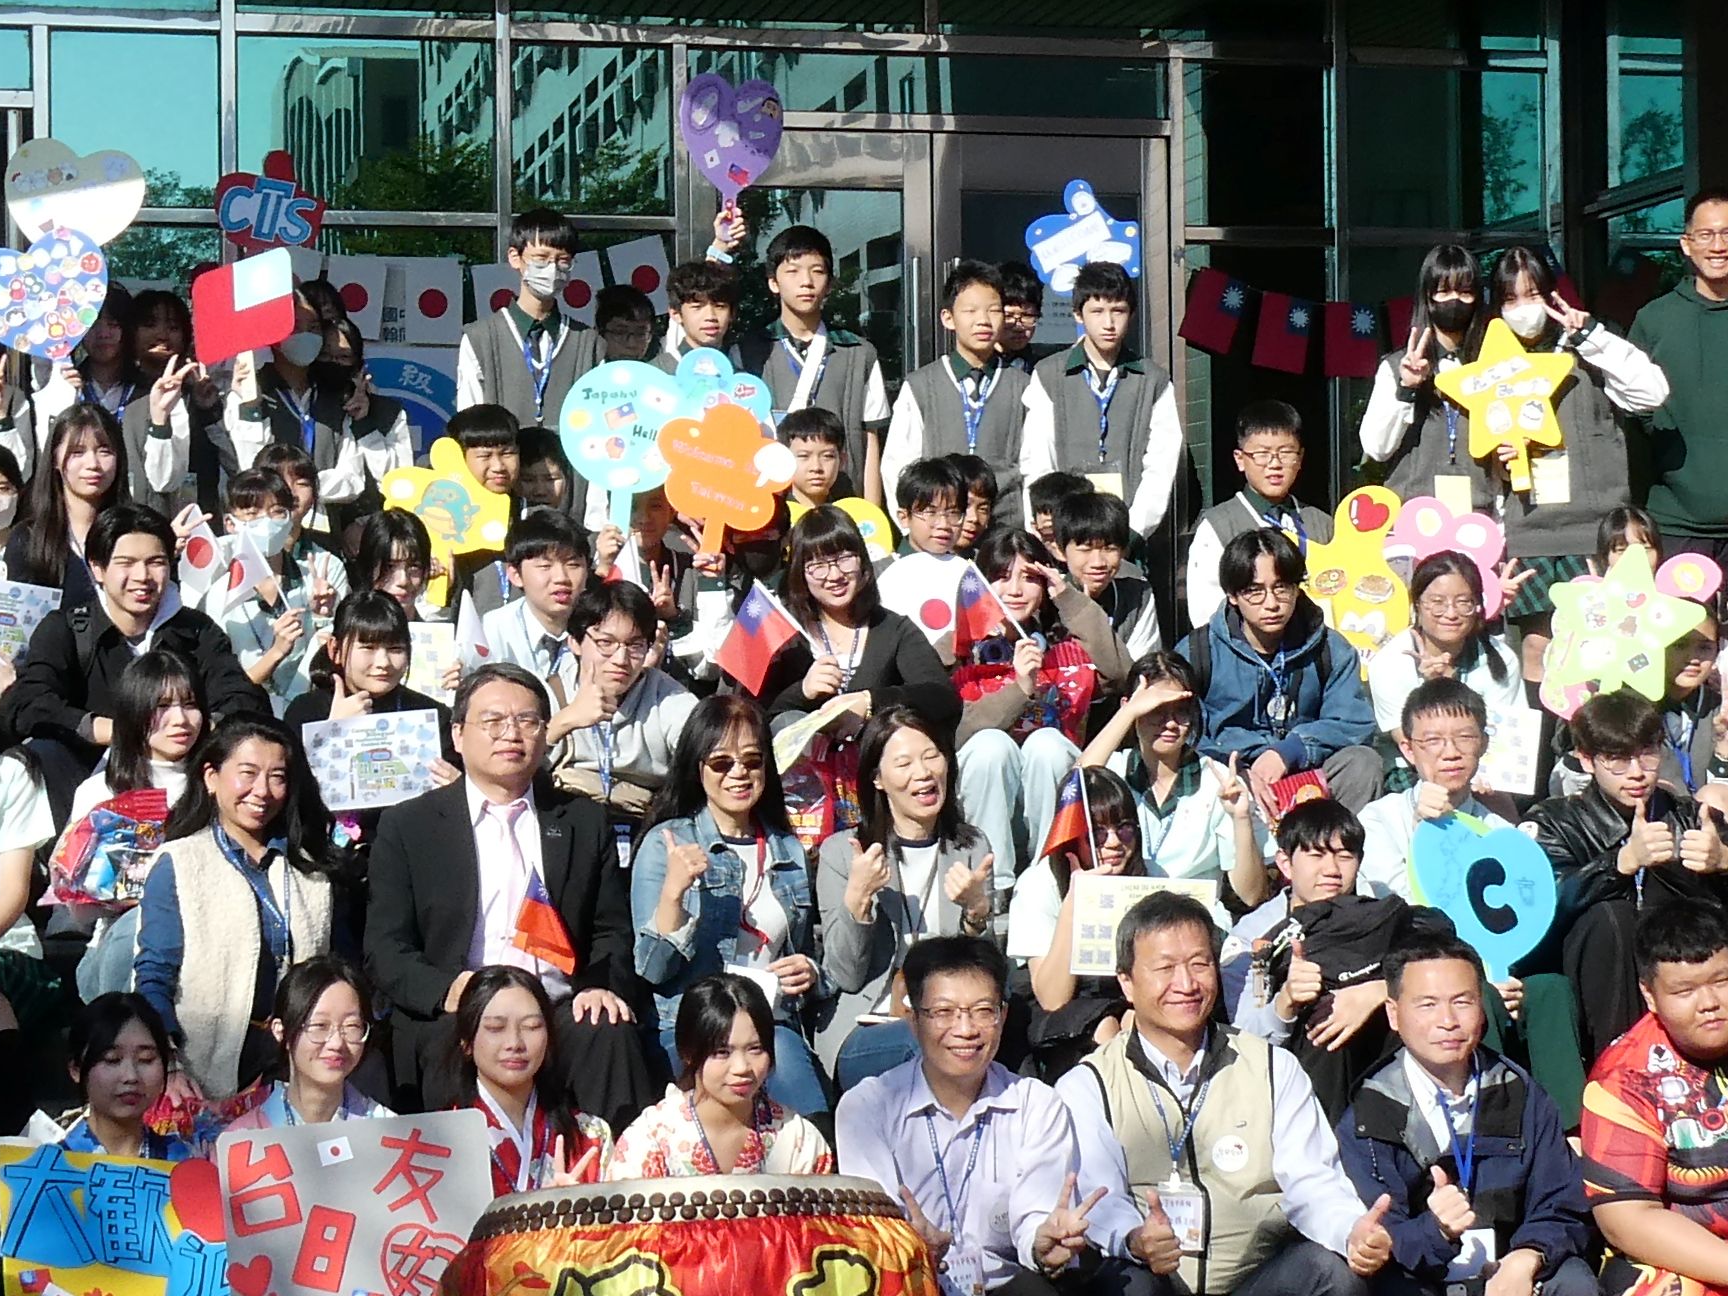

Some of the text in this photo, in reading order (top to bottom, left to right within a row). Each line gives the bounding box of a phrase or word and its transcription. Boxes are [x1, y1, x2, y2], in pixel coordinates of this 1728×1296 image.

[219, 177, 318, 245] CTS
[633, 424, 658, 442] Hell
[1466, 857, 1519, 935] C
